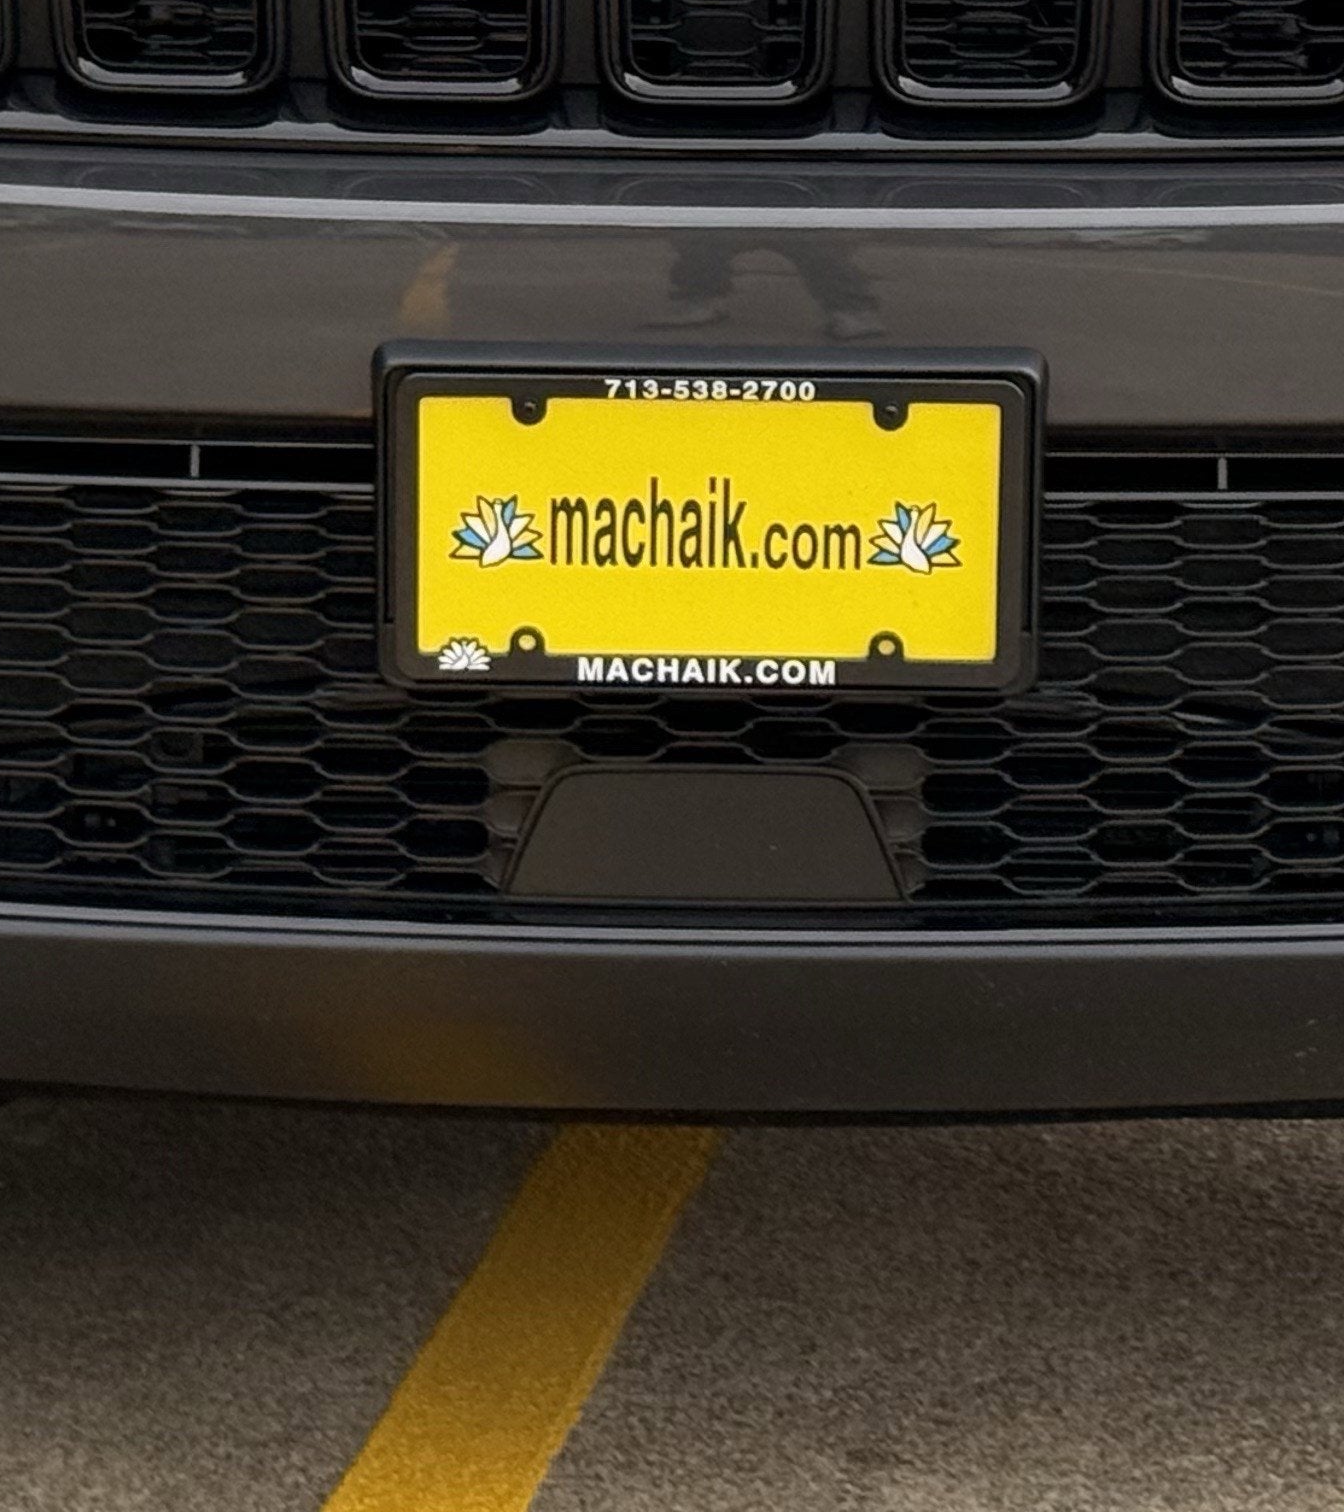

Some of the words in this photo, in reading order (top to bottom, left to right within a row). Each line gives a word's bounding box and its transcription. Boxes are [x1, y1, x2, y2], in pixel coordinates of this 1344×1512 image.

[604, 379, 817, 402] 713-538-2700
[549, 476, 862, 570] machaik.com
[578, 658, 837, 687] MACHAIK.COM
